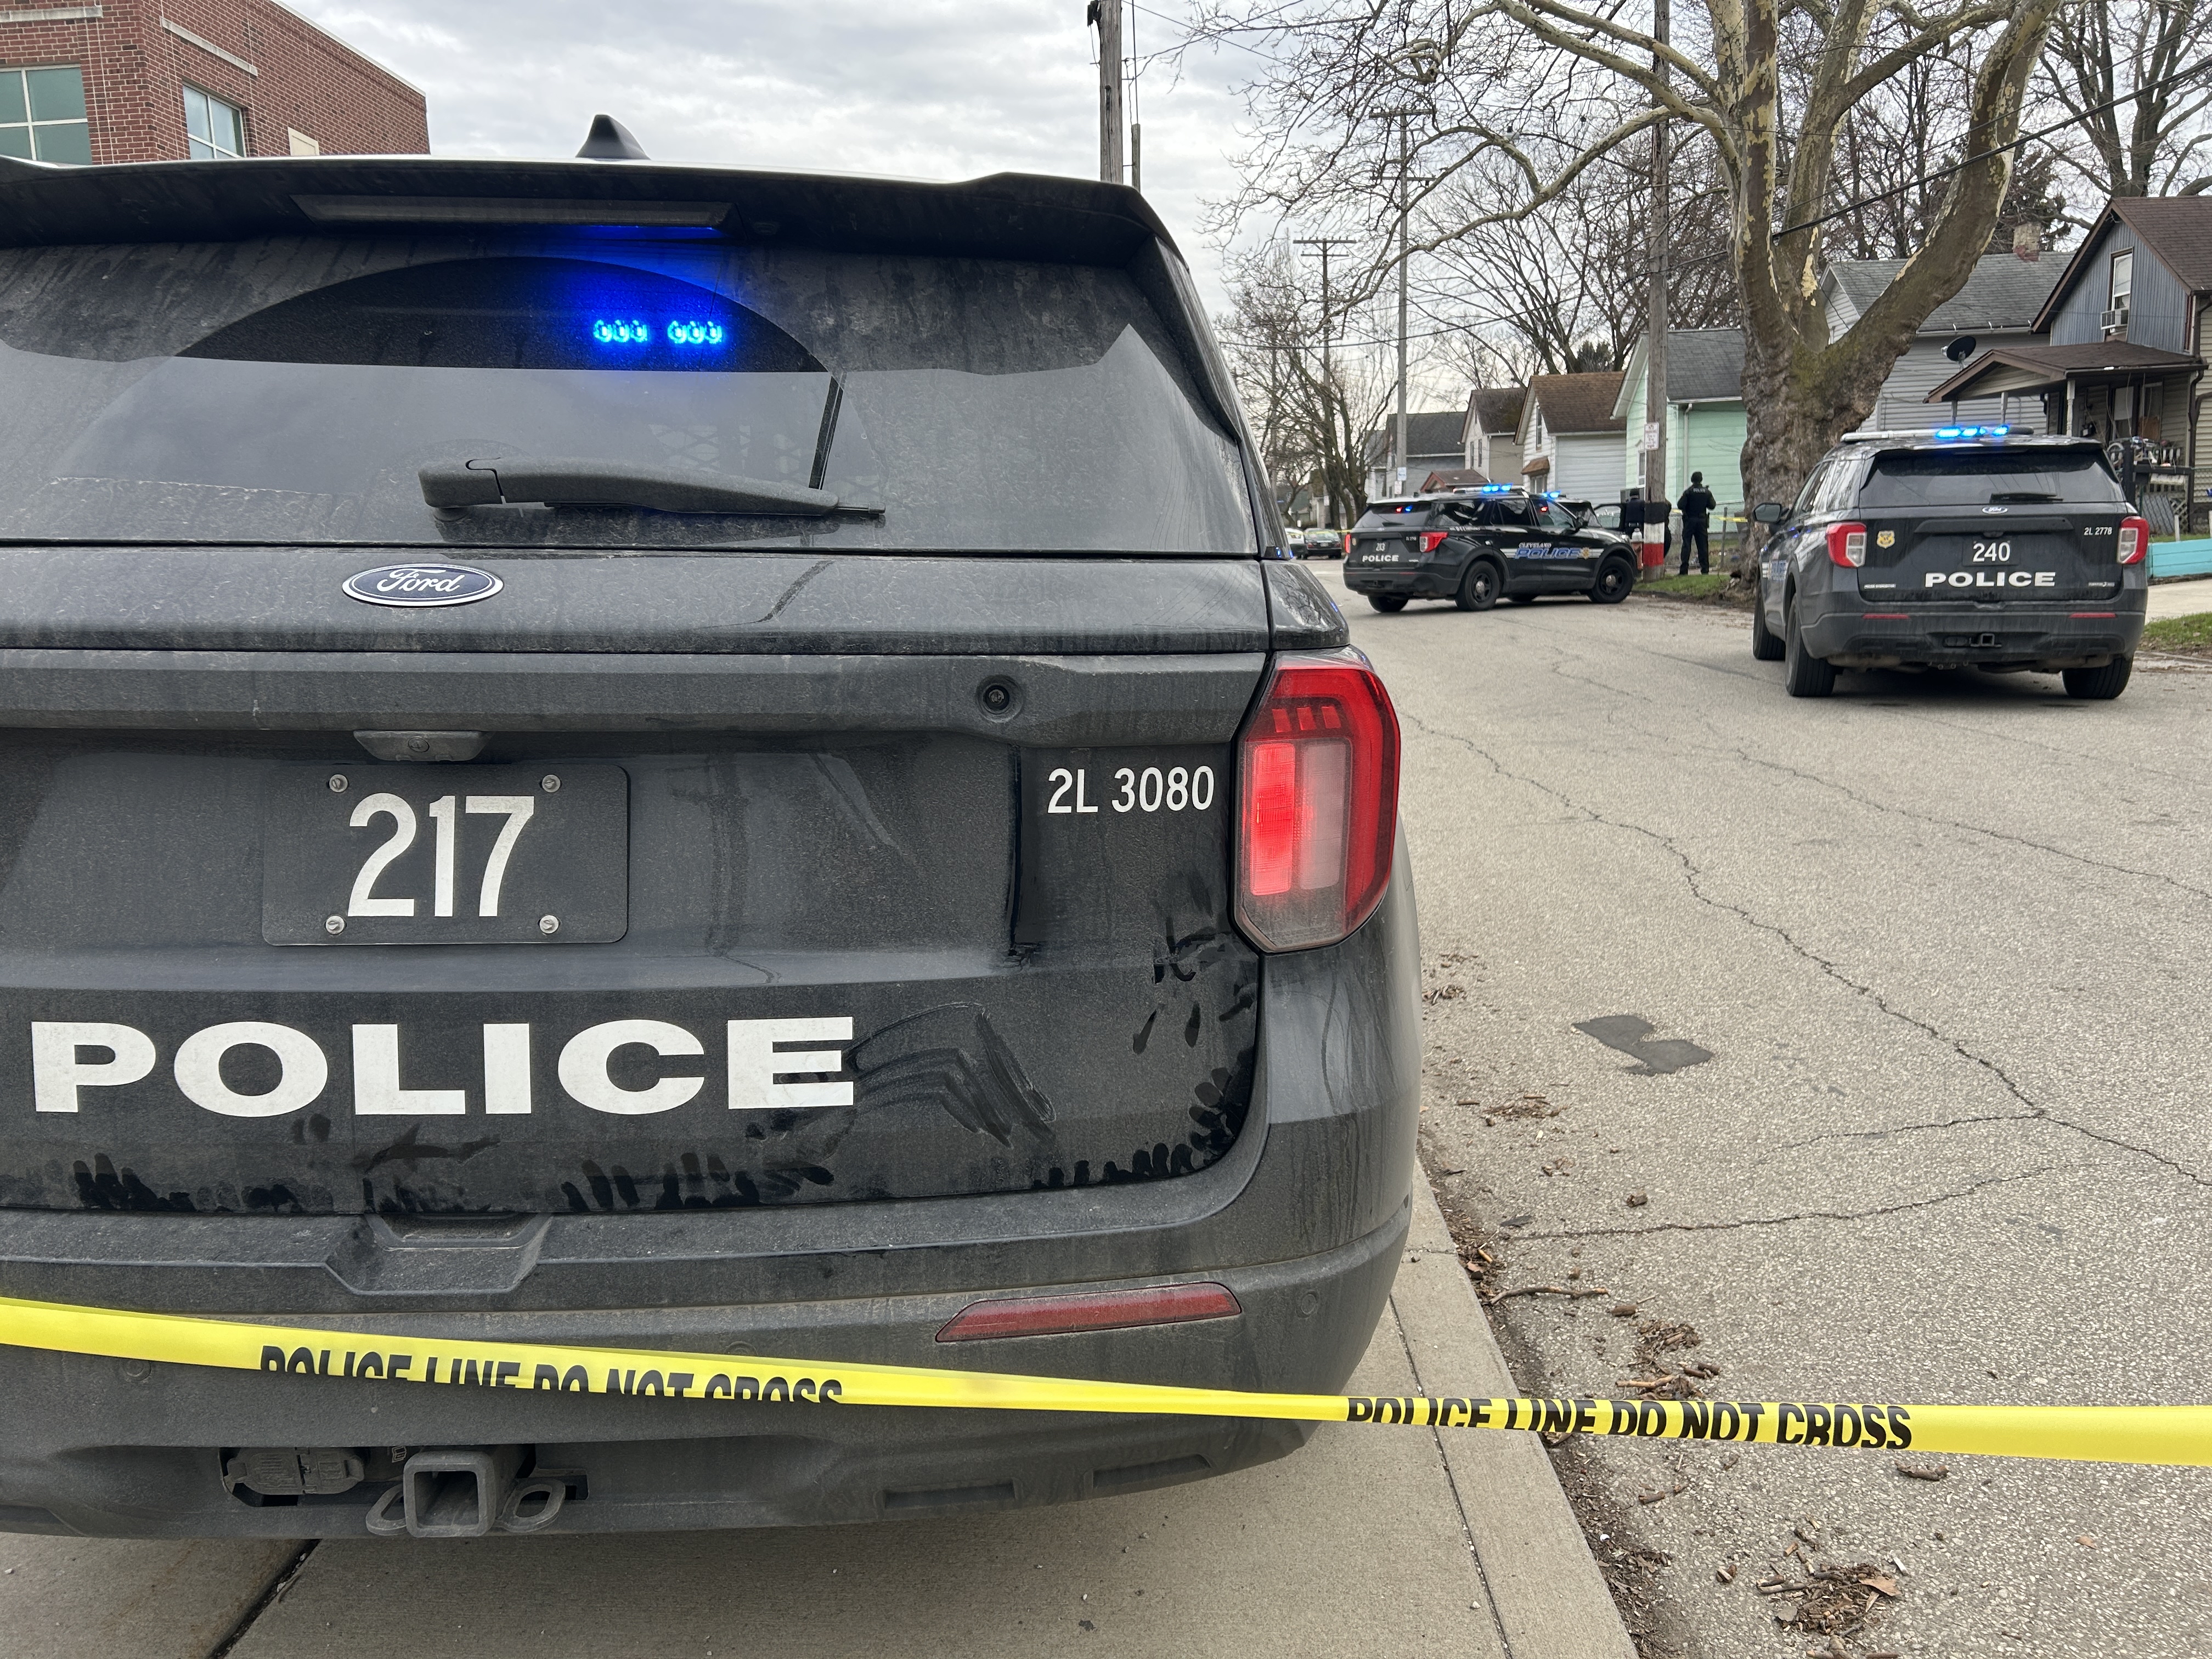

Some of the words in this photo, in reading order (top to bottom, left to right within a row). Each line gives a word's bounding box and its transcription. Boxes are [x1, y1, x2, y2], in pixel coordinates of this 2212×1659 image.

[2084, 527, 2094, 535] 2L
[2095, 527, 2112, 535] 2778
[1515, 548, 1581, 560] POLICE
[1973, 541, 2011, 562] 240
[376, 568, 465, 592] Ford
[1925, 571, 2056, 588] POLICE
[1047, 768, 1098, 813] 2L
[1111, 765, 1215, 813] 3080
[347, 792, 535, 917] 217
[31, 1016, 854, 1118] POLICE
[1346, 1397, 1492, 1428] POLICE
[1504, 1398, 1598, 1434] LINE
[1608, 1400, 1667, 1437] DO
[1679, 1401, 1765, 1442] NOT
[1776, 1403, 1912, 1449] CROSS
